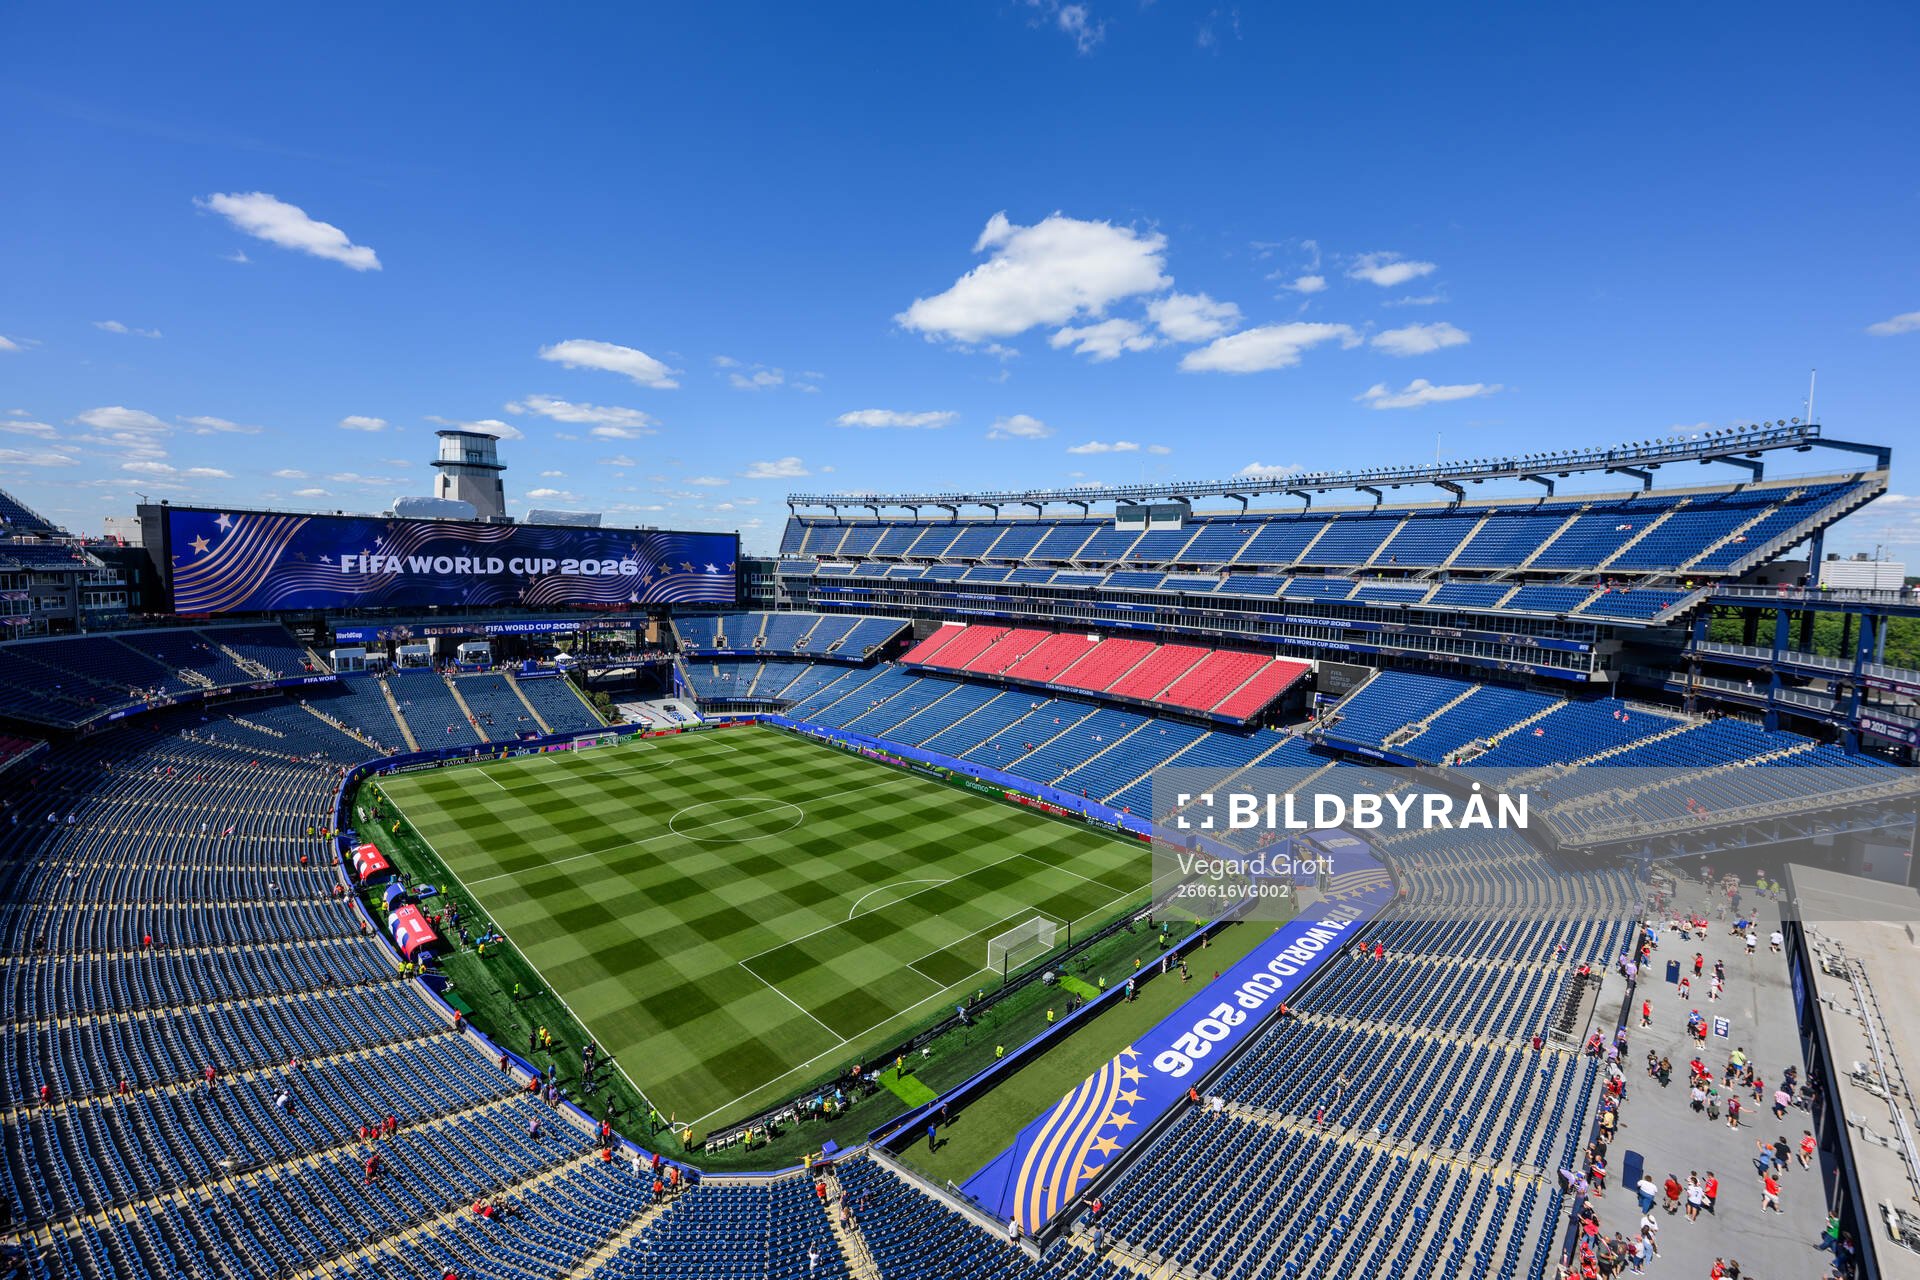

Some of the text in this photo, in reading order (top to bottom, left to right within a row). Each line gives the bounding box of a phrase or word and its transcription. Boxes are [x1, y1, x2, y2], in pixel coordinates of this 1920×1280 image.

[341, 554, 638, 576] FIFA WORLD CUP 2026
[424, 627, 463, 635] BOSTON
[965, 781, 989, 792] aramco
[1151, 838, 1174, 849] Lenovo
[1153, 904, 1363, 1078] FIFA WORLD CUP 2026
